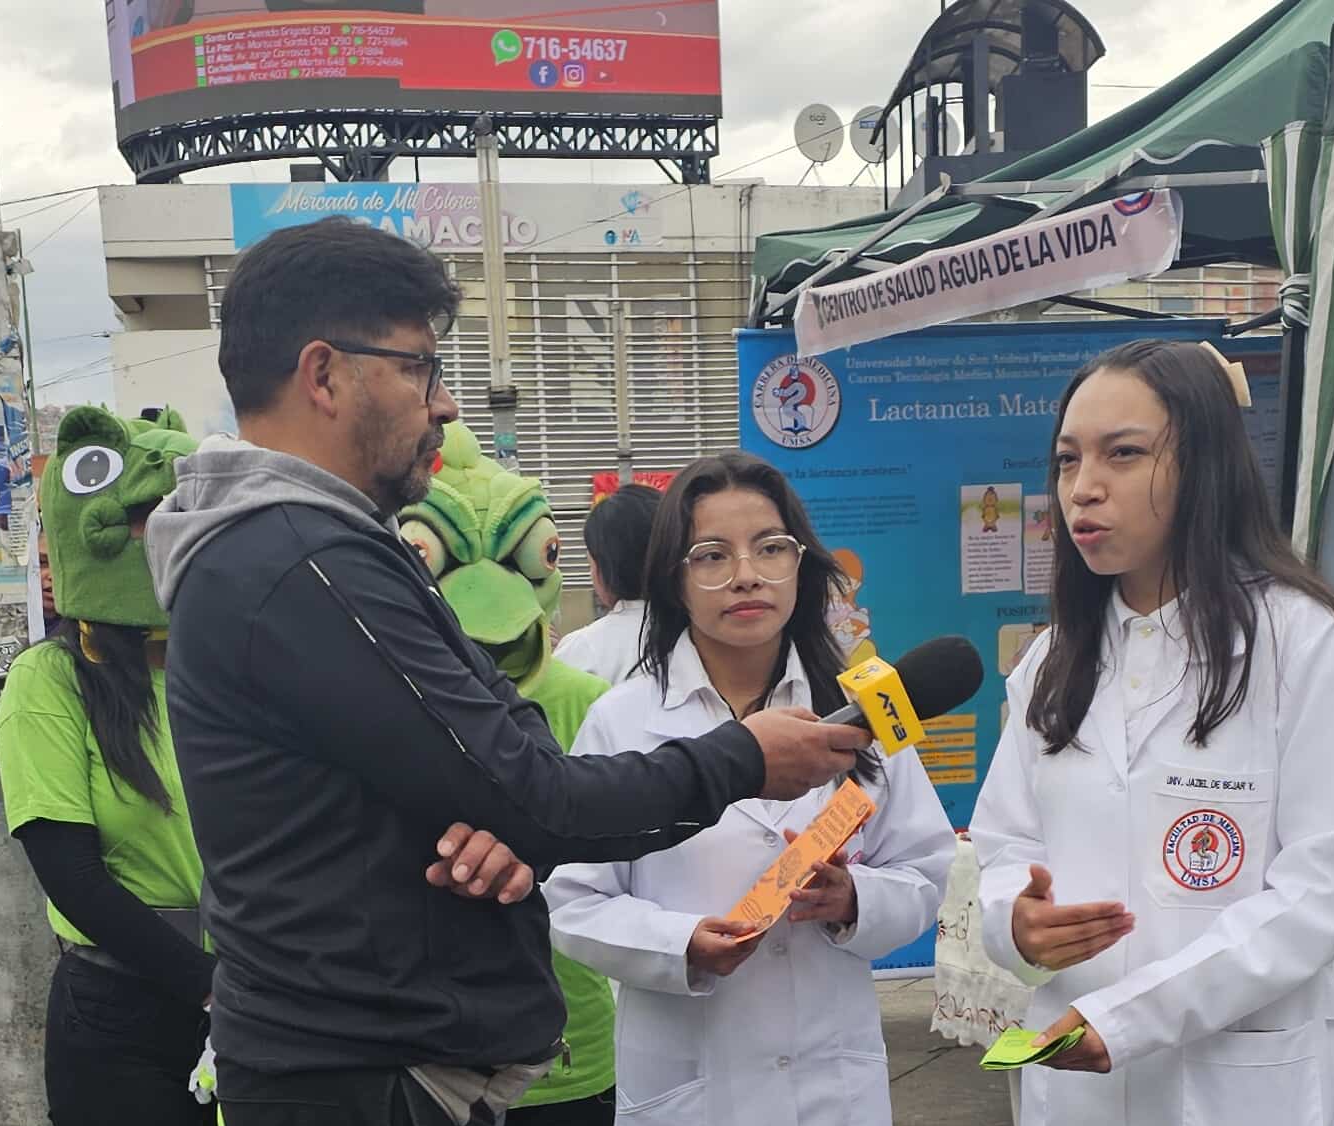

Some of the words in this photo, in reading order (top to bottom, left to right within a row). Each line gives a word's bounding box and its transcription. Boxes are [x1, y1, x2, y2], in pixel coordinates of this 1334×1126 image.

[523, 36, 628, 61] 716-54637
[276, 186, 358, 212] Mercado
[362, 187, 384, 210] de
[386, 186, 418, 211] Mil
[821, 285, 868, 320] CENTRO
[867, 279, 887, 310] DE
[885, 264, 936, 302] SALUD
[939, 249, 994, 292] AGUA
[994, 239, 1022, 276] DE
[1024, 230, 1055, 267] LA
[1056, 214, 1117, 258] VIDA
[868, 395, 992, 422] Lactancia
[998, 393, 1061, 418] Mate
[1210, 780, 1221, 789] DE
[1165, 814, 1199, 855] FACULTAD
[1202, 813, 1216, 823] DE
[1218, 817, 1240, 858] MEDICINA
[1180, 870, 1220, 887] UMSA
